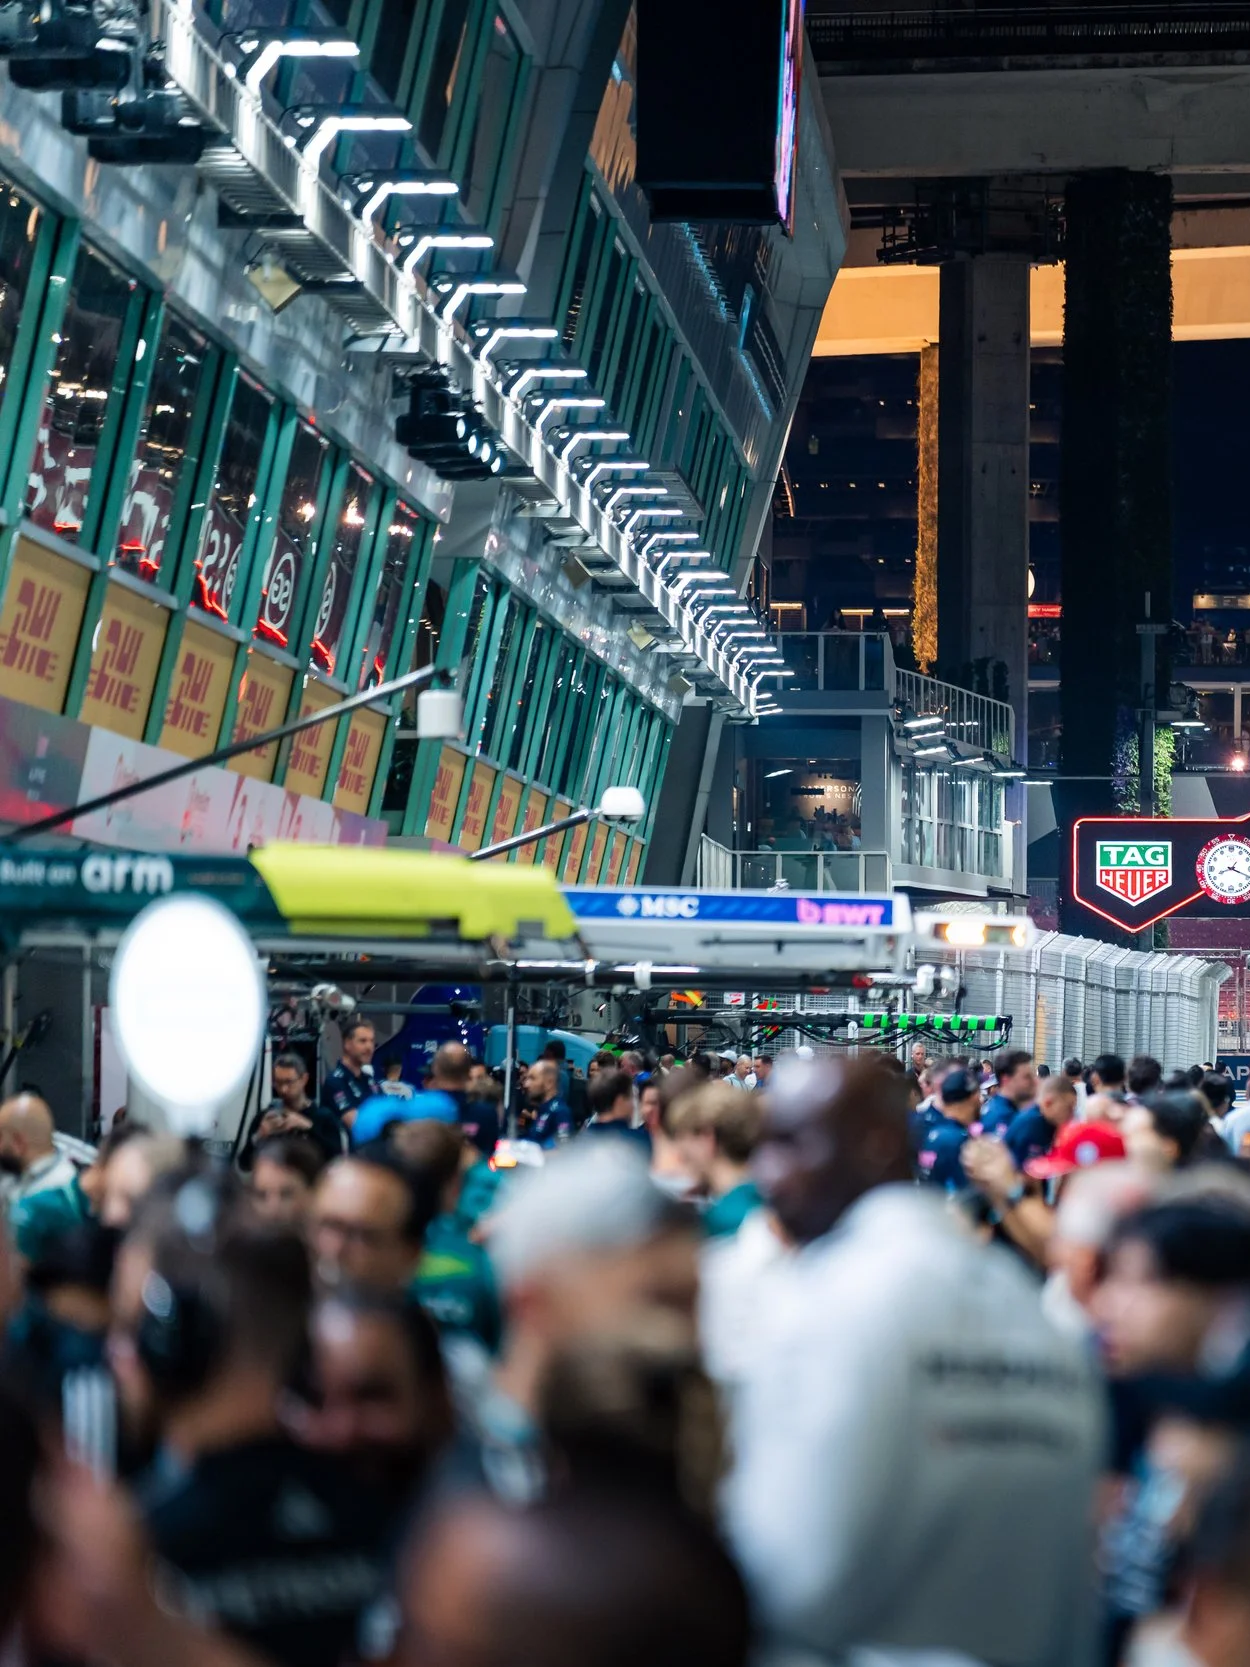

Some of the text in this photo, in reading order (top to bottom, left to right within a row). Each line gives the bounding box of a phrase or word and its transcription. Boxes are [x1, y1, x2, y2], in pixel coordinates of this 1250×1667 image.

[1103, 846, 1165, 866] TAG
[81, 852, 174, 894] arm
[1101, 870, 1167, 901] HEUER
[640, 895, 700, 919] MSC
